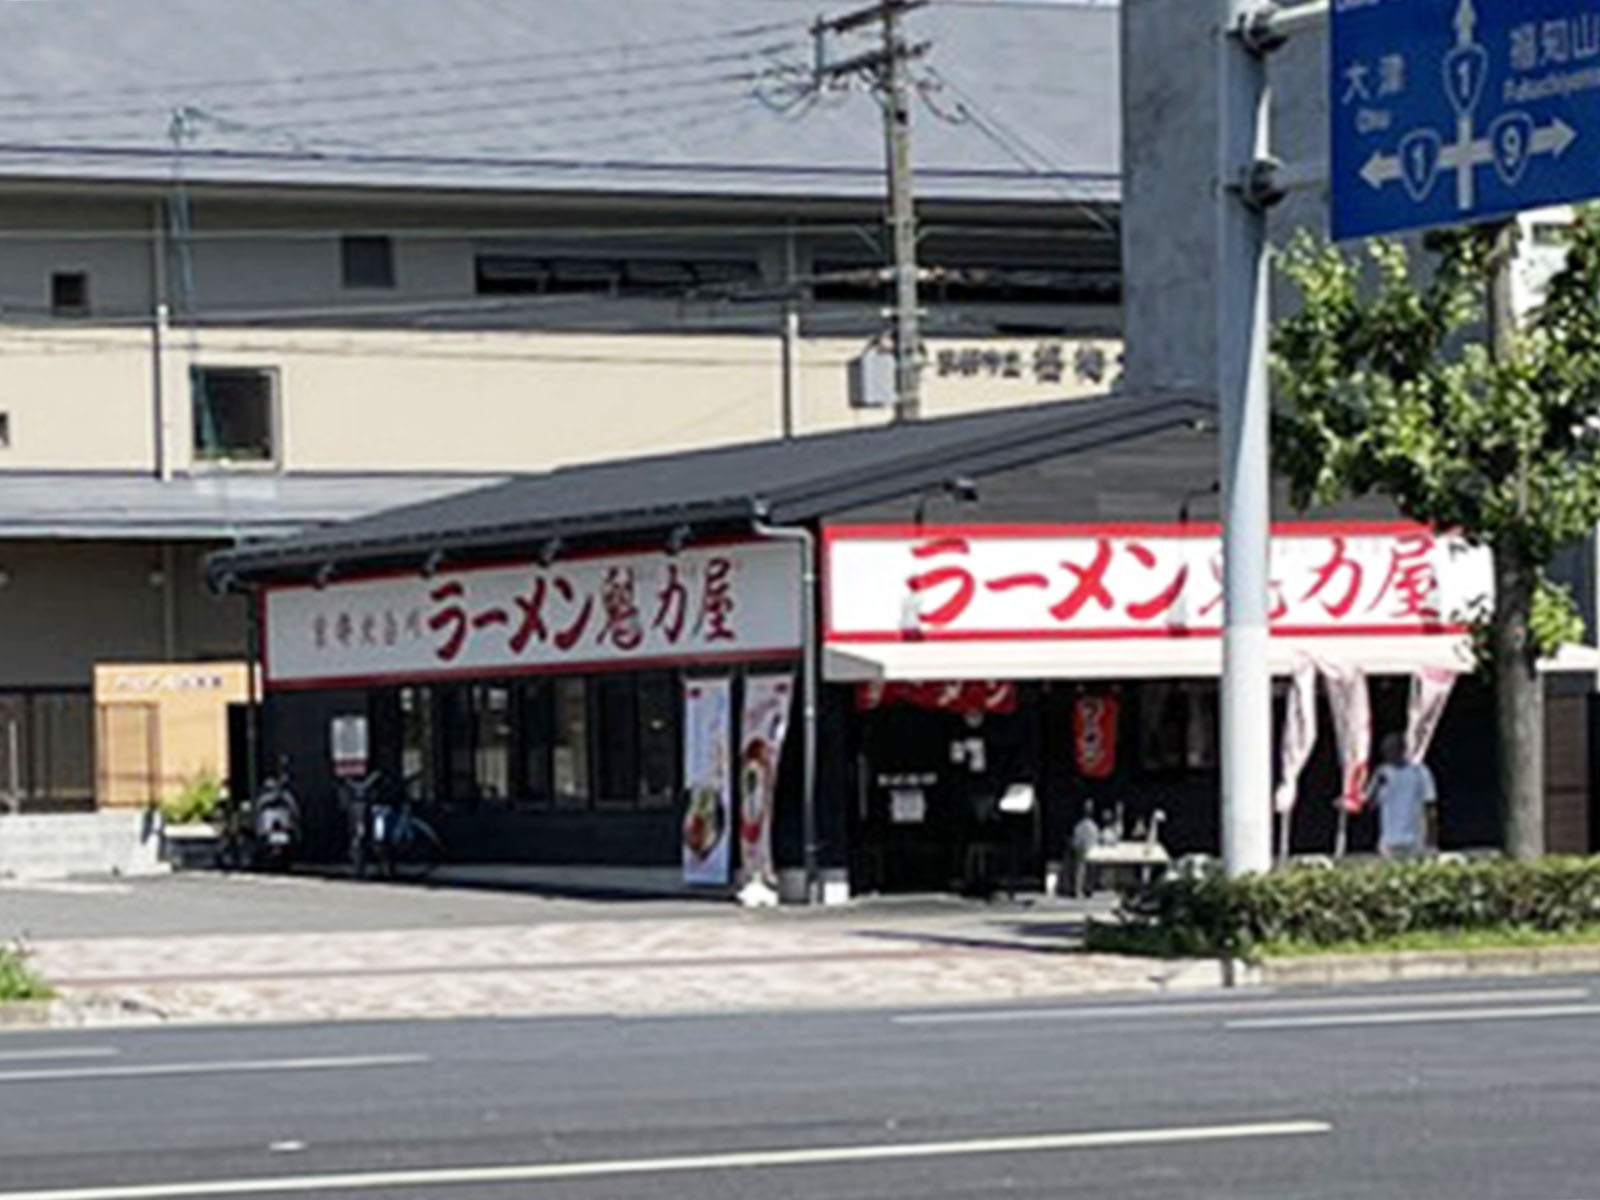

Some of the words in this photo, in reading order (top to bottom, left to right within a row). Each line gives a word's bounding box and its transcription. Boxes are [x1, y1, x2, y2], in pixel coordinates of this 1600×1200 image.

[1457, 60, 1471, 98] 1
[1411, 145, 1425, 181] 1
[1502, 127, 1521, 167] 9
